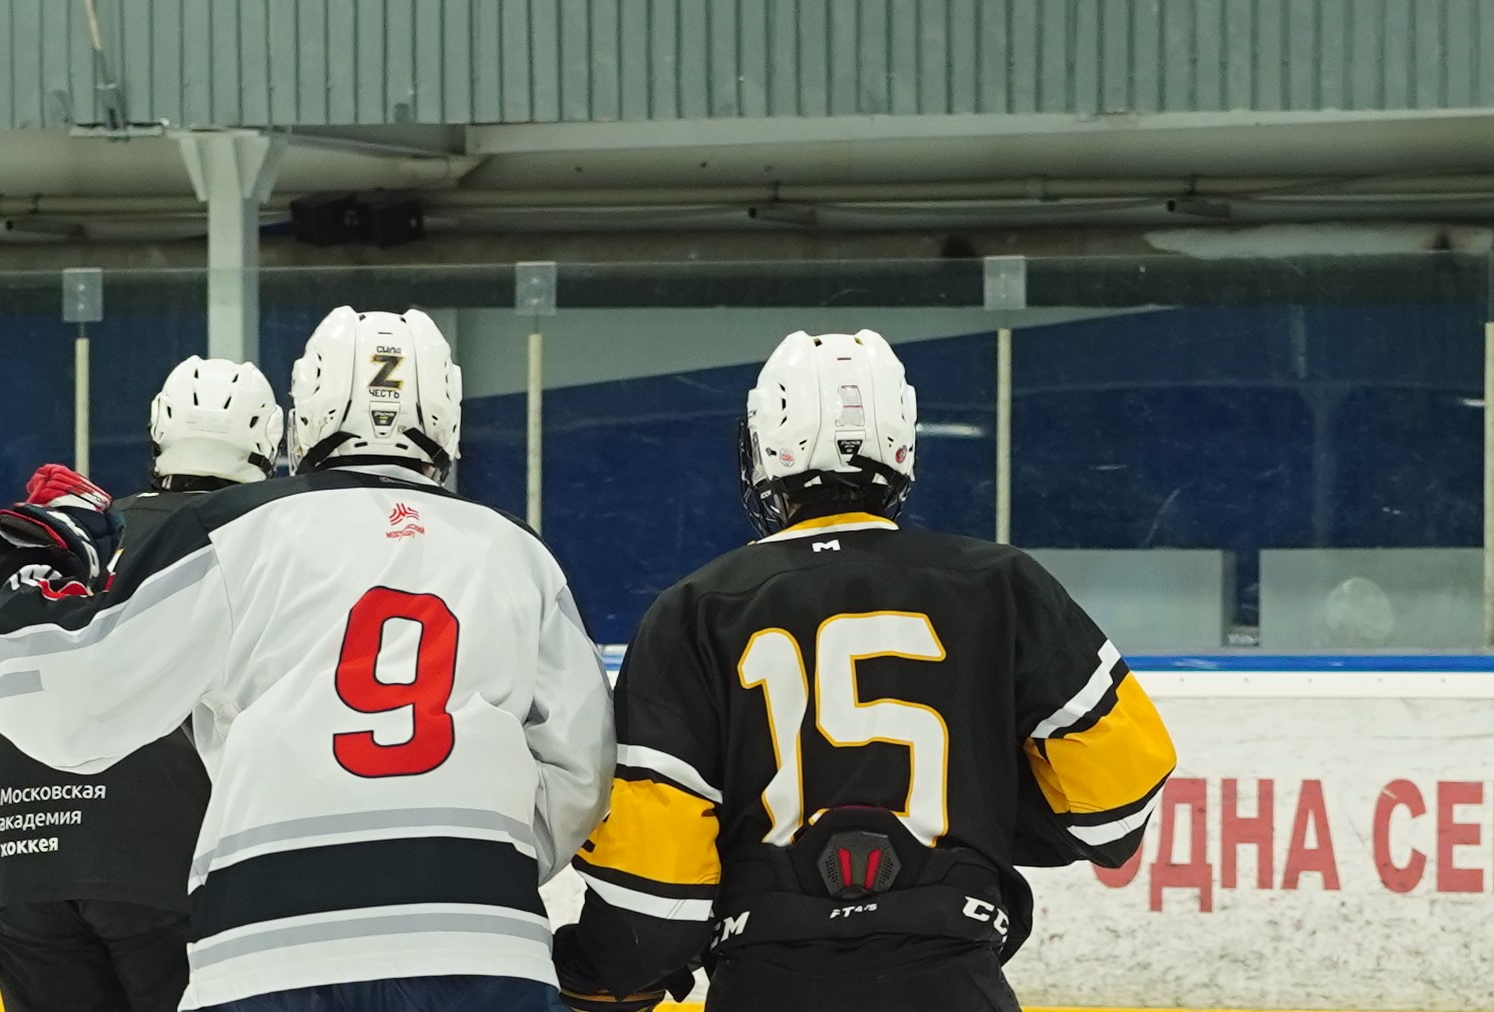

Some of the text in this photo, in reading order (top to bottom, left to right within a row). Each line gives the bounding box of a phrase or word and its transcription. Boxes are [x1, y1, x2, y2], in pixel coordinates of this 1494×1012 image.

[368, 354, 405, 390] Z
[333, 585, 460, 779] 9
[737, 610, 949, 848] 15
[0, 784, 106, 806] Московская
[0, 837, 59, 858] хоккея
[1372, 779, 1494, 894] СЕ
[962, 895, 1010, 943] CC
